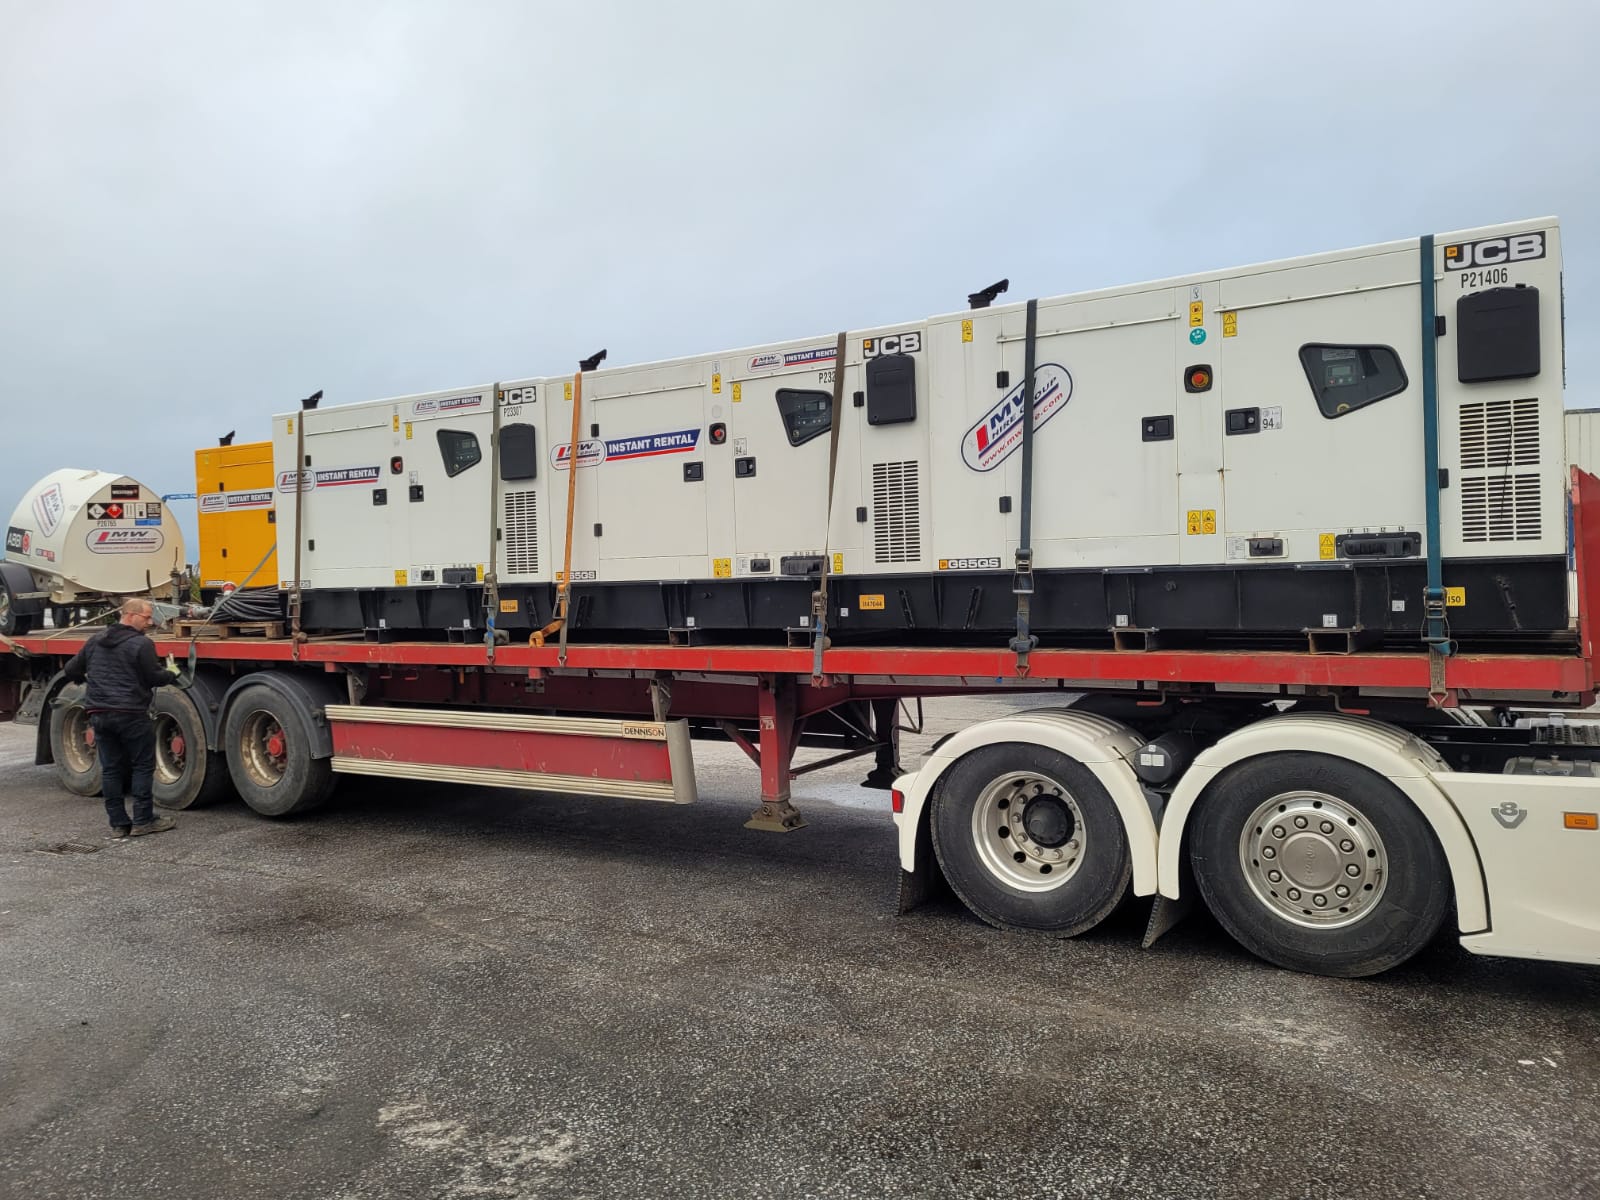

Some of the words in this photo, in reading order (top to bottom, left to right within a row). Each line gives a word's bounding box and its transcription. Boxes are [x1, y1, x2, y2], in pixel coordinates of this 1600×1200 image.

[1446, 234, 1543, 270] JCB
[1460, 268, 1508, 289] P21406
[863, 333, 921, 358] JCB
[786, 352, 814, 363] INSTANT
[816, 348, 838, 358] RENTA
[499, 387, 536, 406] JCB
[991, 412, 1017, 439] HIRE
[1262, 418, 1274, 429] 94
[608, 439, 651, 454] INSTANT
[653, 433, 695, 448] RENTAL
[317, 471, 348, 481] INSTANT
[349, 468, 377, 479] RENTAL
[948, 558, 1000, 569] G65QS
[624, 727, 665, 737] DENNISON
